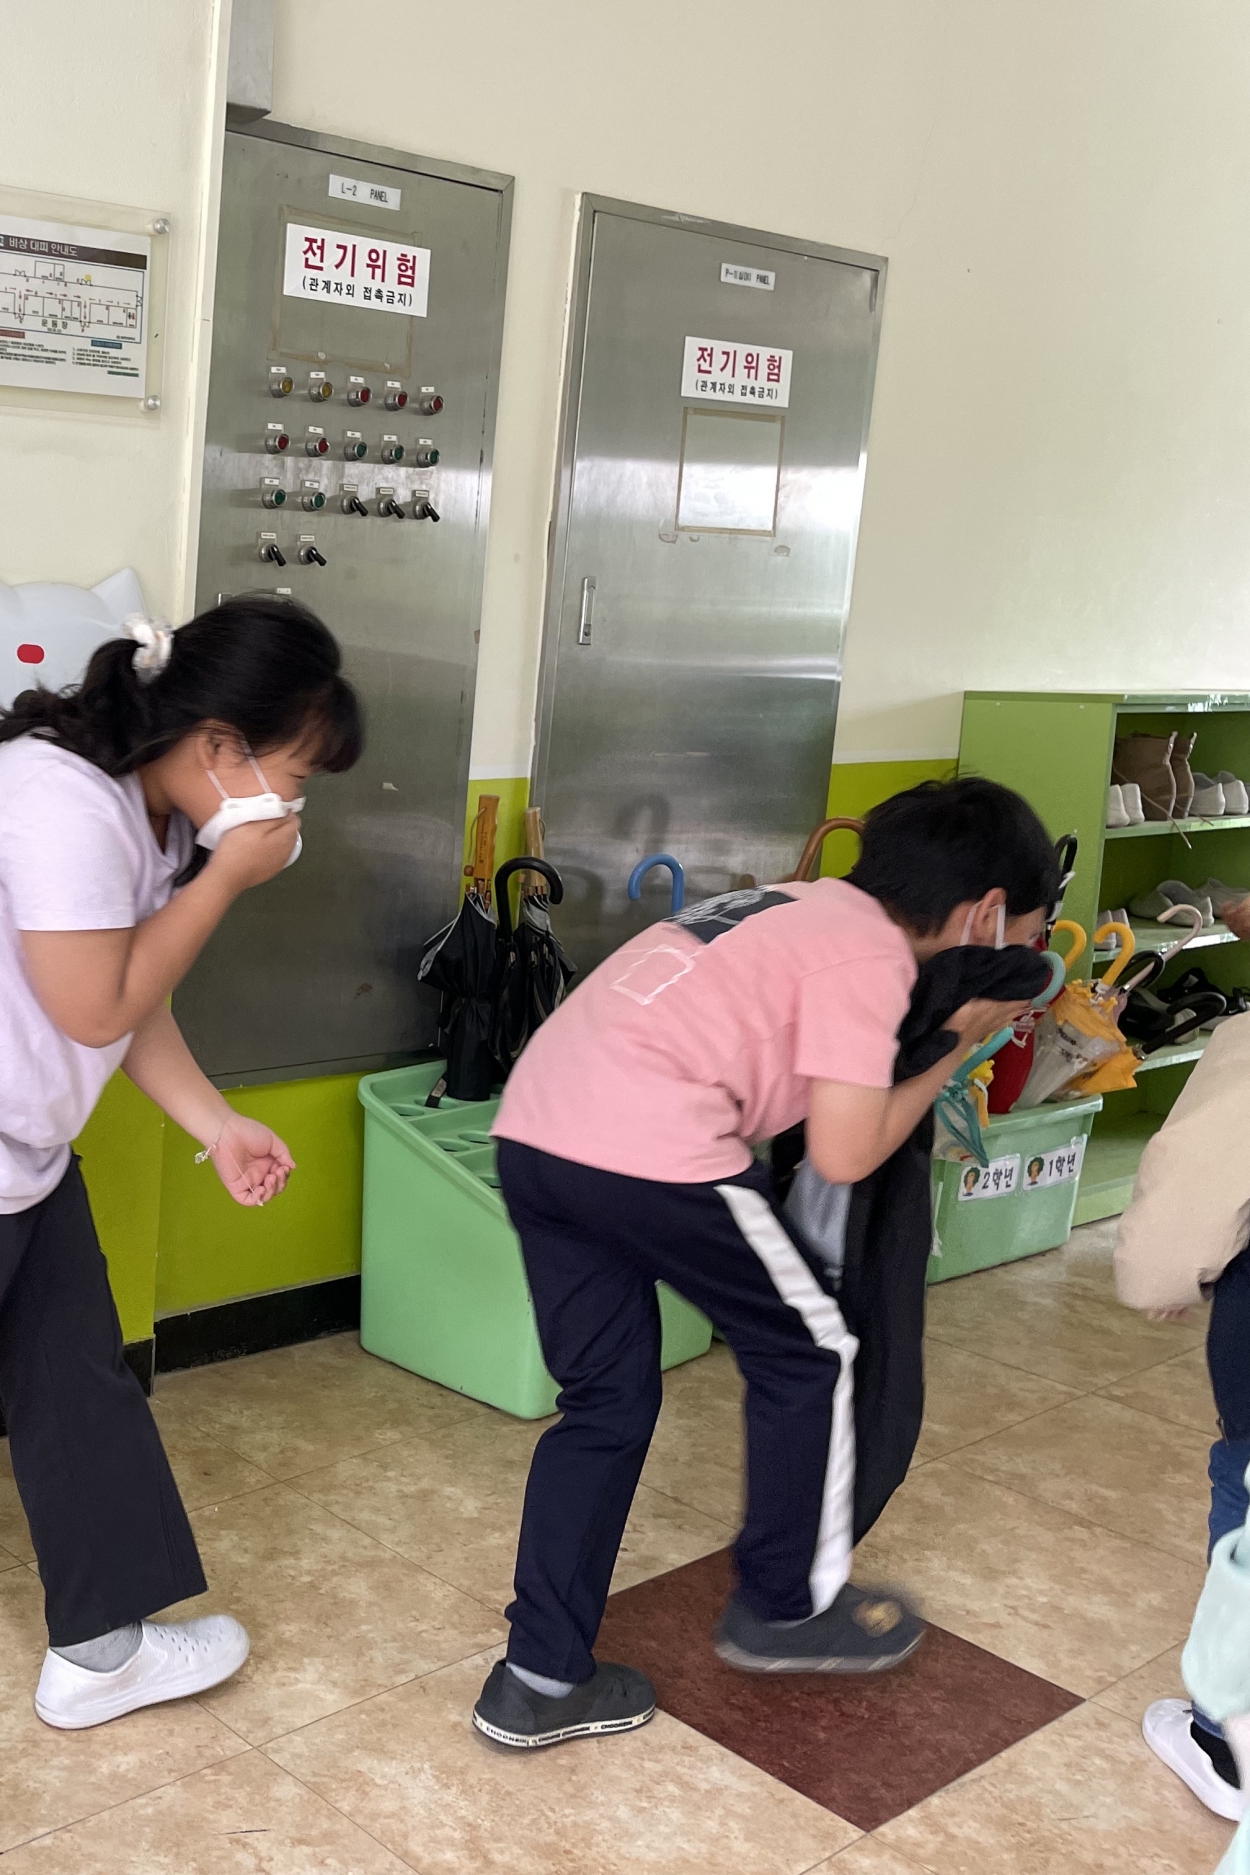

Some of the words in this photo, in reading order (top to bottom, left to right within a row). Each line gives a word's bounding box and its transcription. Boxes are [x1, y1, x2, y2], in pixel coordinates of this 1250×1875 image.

[341, 183, 357, 197] L-2
[369, 188, 389, 203] PANEL
[8, 236, 28, 250] 비상
[30, 239, 49, 253] 대피
[50, 242, 78, 257] 안내도
[302, 236, 417, 288] 전기위험
[302, 275, 356, 298] (관계자외
[362, 286, 413, 307] 접촉금지)
[696, 346, 783, 383] 전기위험
[695, 379, 735, 396] (관계자외
[740, 384, 778, 400] 접촉금지)
[1048, 1152, 1077, 1177] 1학년
[981, 1167, 1014, 1191] 2학년
